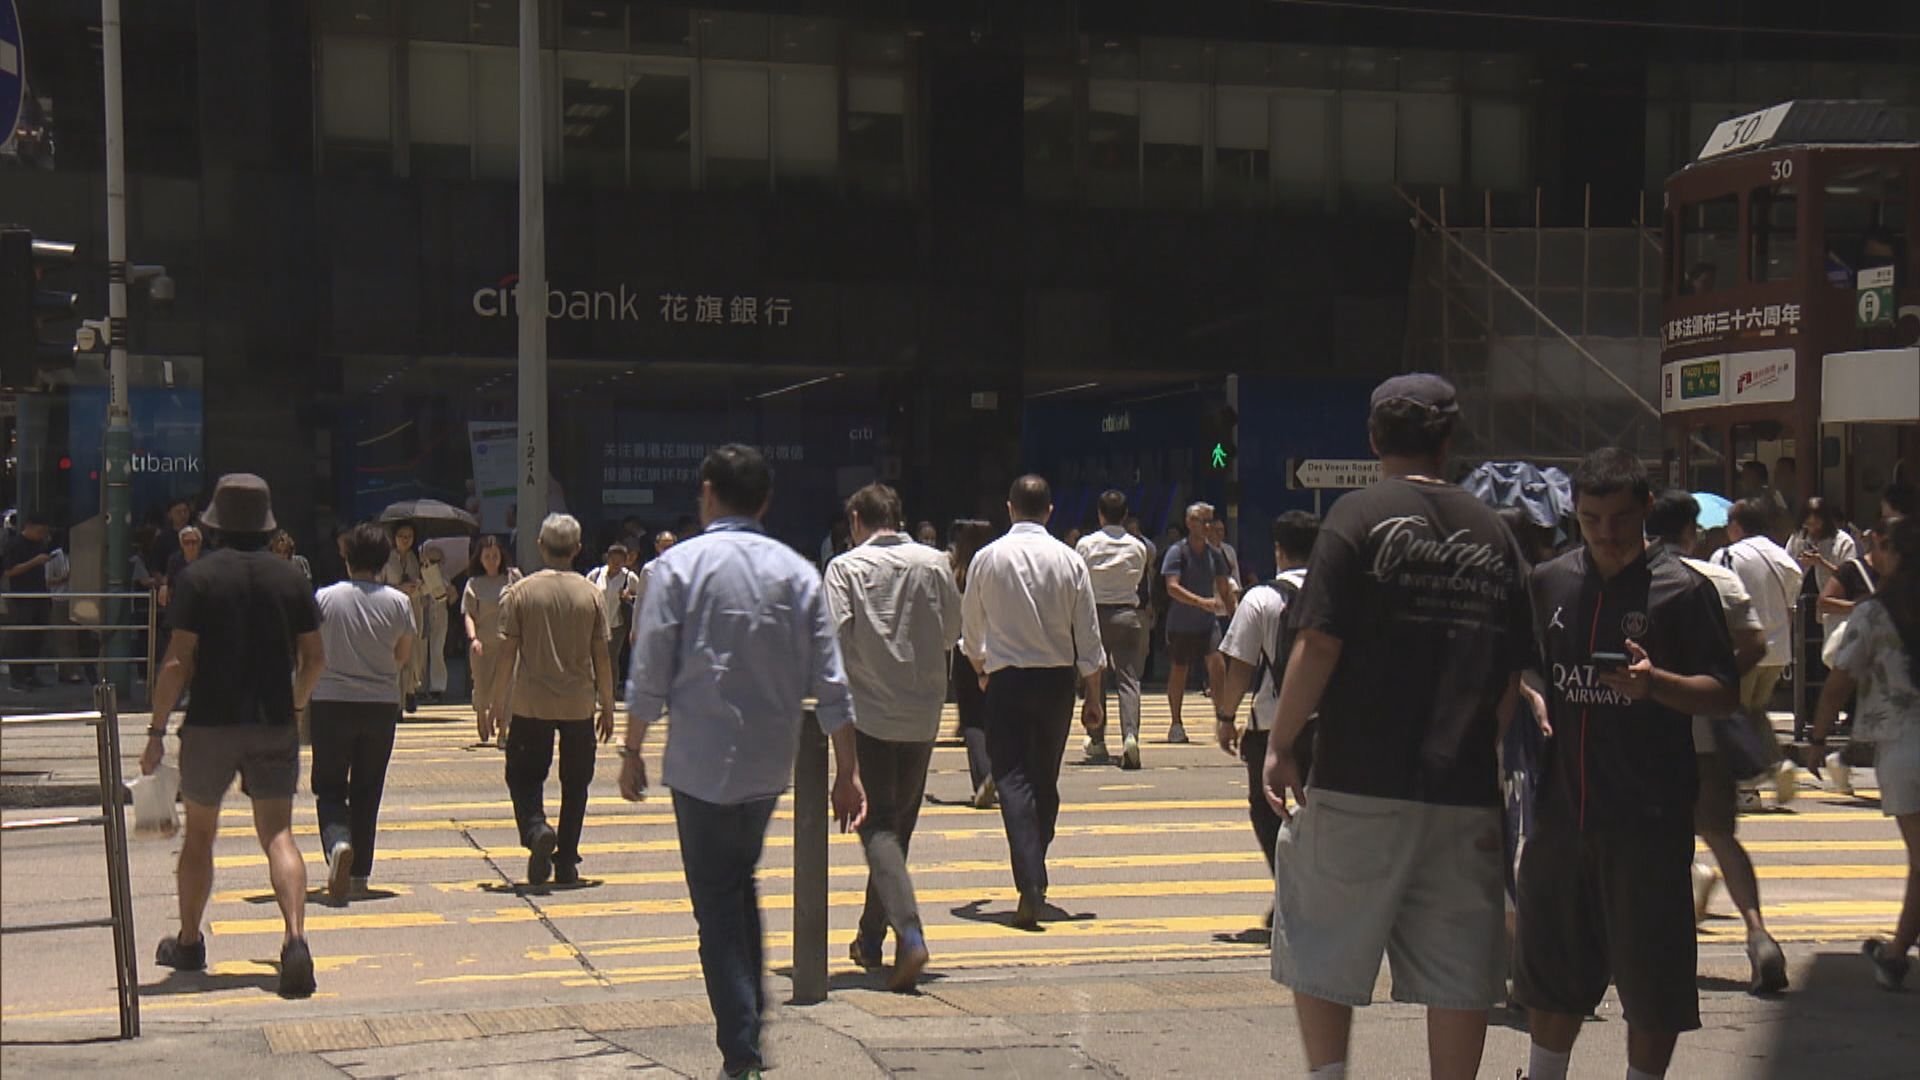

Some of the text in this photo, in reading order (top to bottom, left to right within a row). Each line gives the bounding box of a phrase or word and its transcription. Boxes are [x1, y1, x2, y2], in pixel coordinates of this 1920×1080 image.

[1722, 115, 1762, 150] 30
[1770, 158, 1794, 181] 30
[473, 274, 640, 321] citbank
[659, 293, 793, 326] 花旗銀行
[849, 424, 873, 441] citi
[131, 452, 200, 473] tibank
[1552, 662, 1600, 691] QAT
[1565, 688, 1632, 707] AIRWAYS
